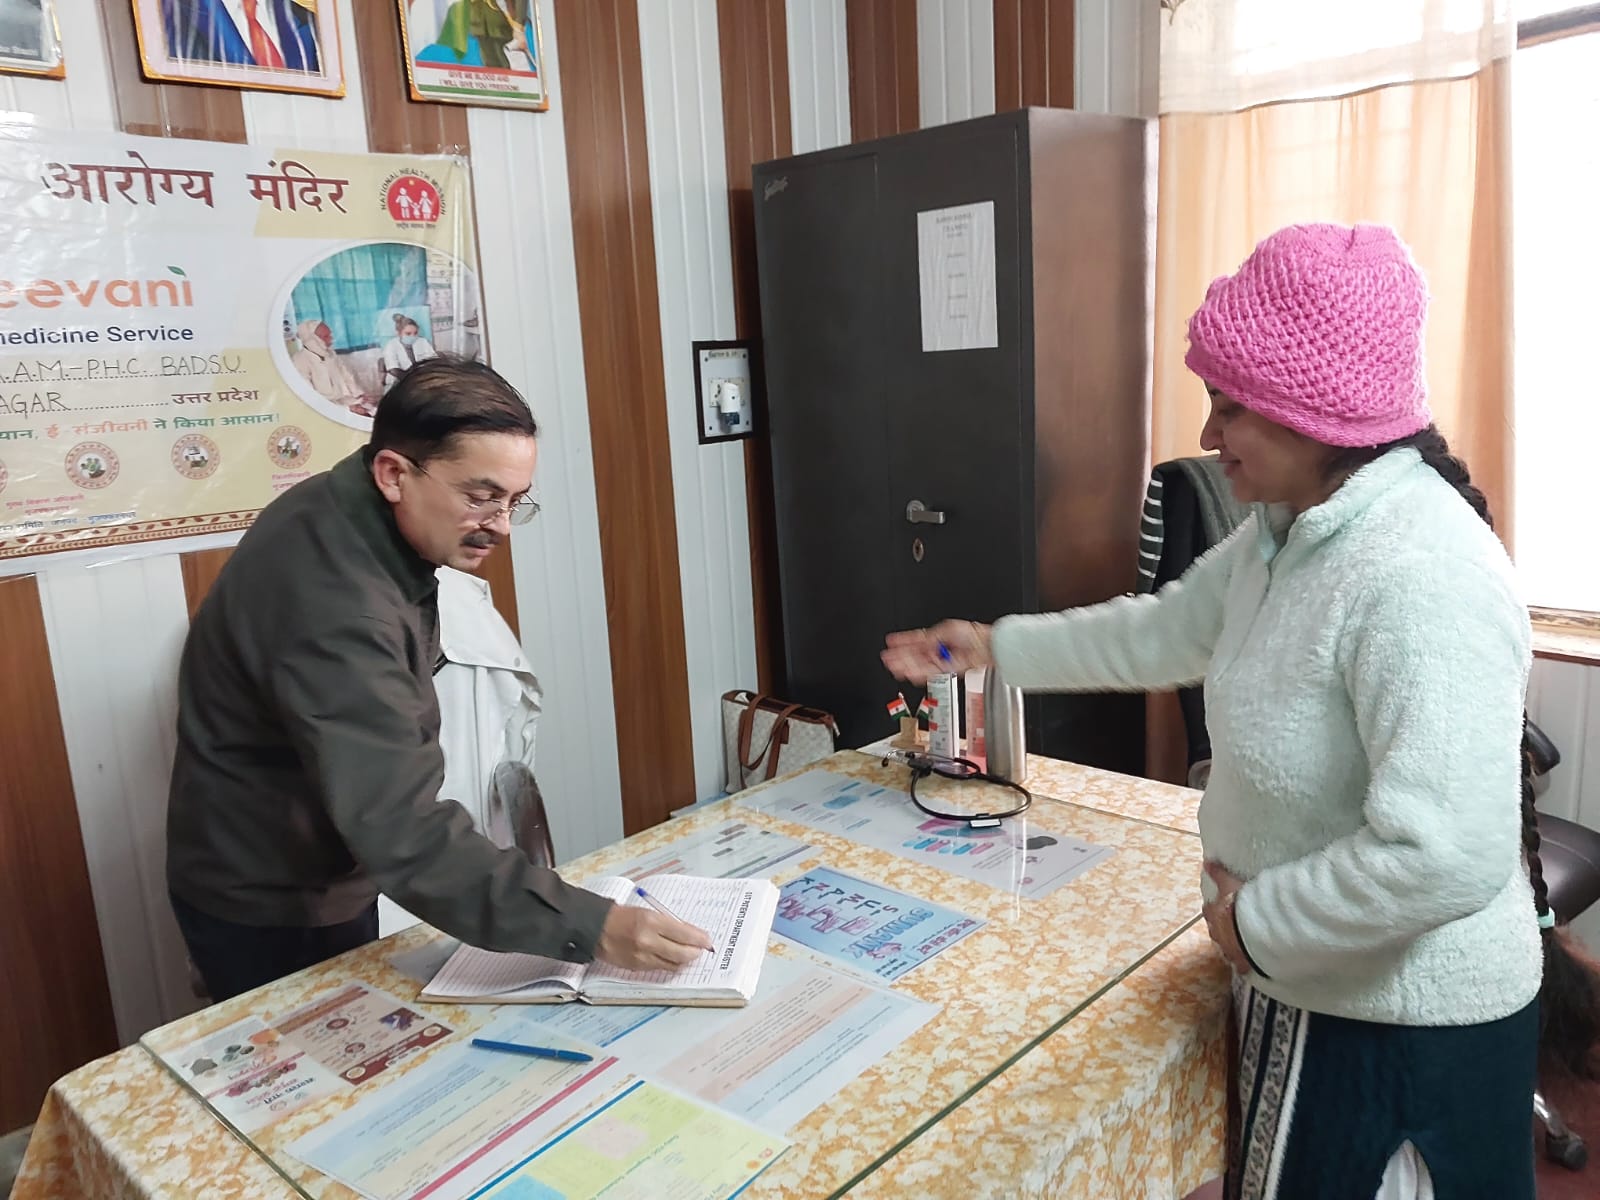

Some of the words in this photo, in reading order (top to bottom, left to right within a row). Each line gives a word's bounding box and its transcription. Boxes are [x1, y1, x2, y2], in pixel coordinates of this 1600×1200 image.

[42, 150, 214, 208] आरोग्य
[246, 160, 348, 213] मंदिर
[379, 171, 399, 210] NATIONAL
[107, 325, 194, 344] Service
[161, 355, 241, 377] BADSU
[171, 392, 212, 404] उत्तर
[217, 387, 260, 402] प्रदेश
[152, 417, 168, 430] ने
[173, 416, 215, 429] किया
[728, 919, 744, 947] DEPARTMENT
[719, 947, 735, 970] REGISTER
